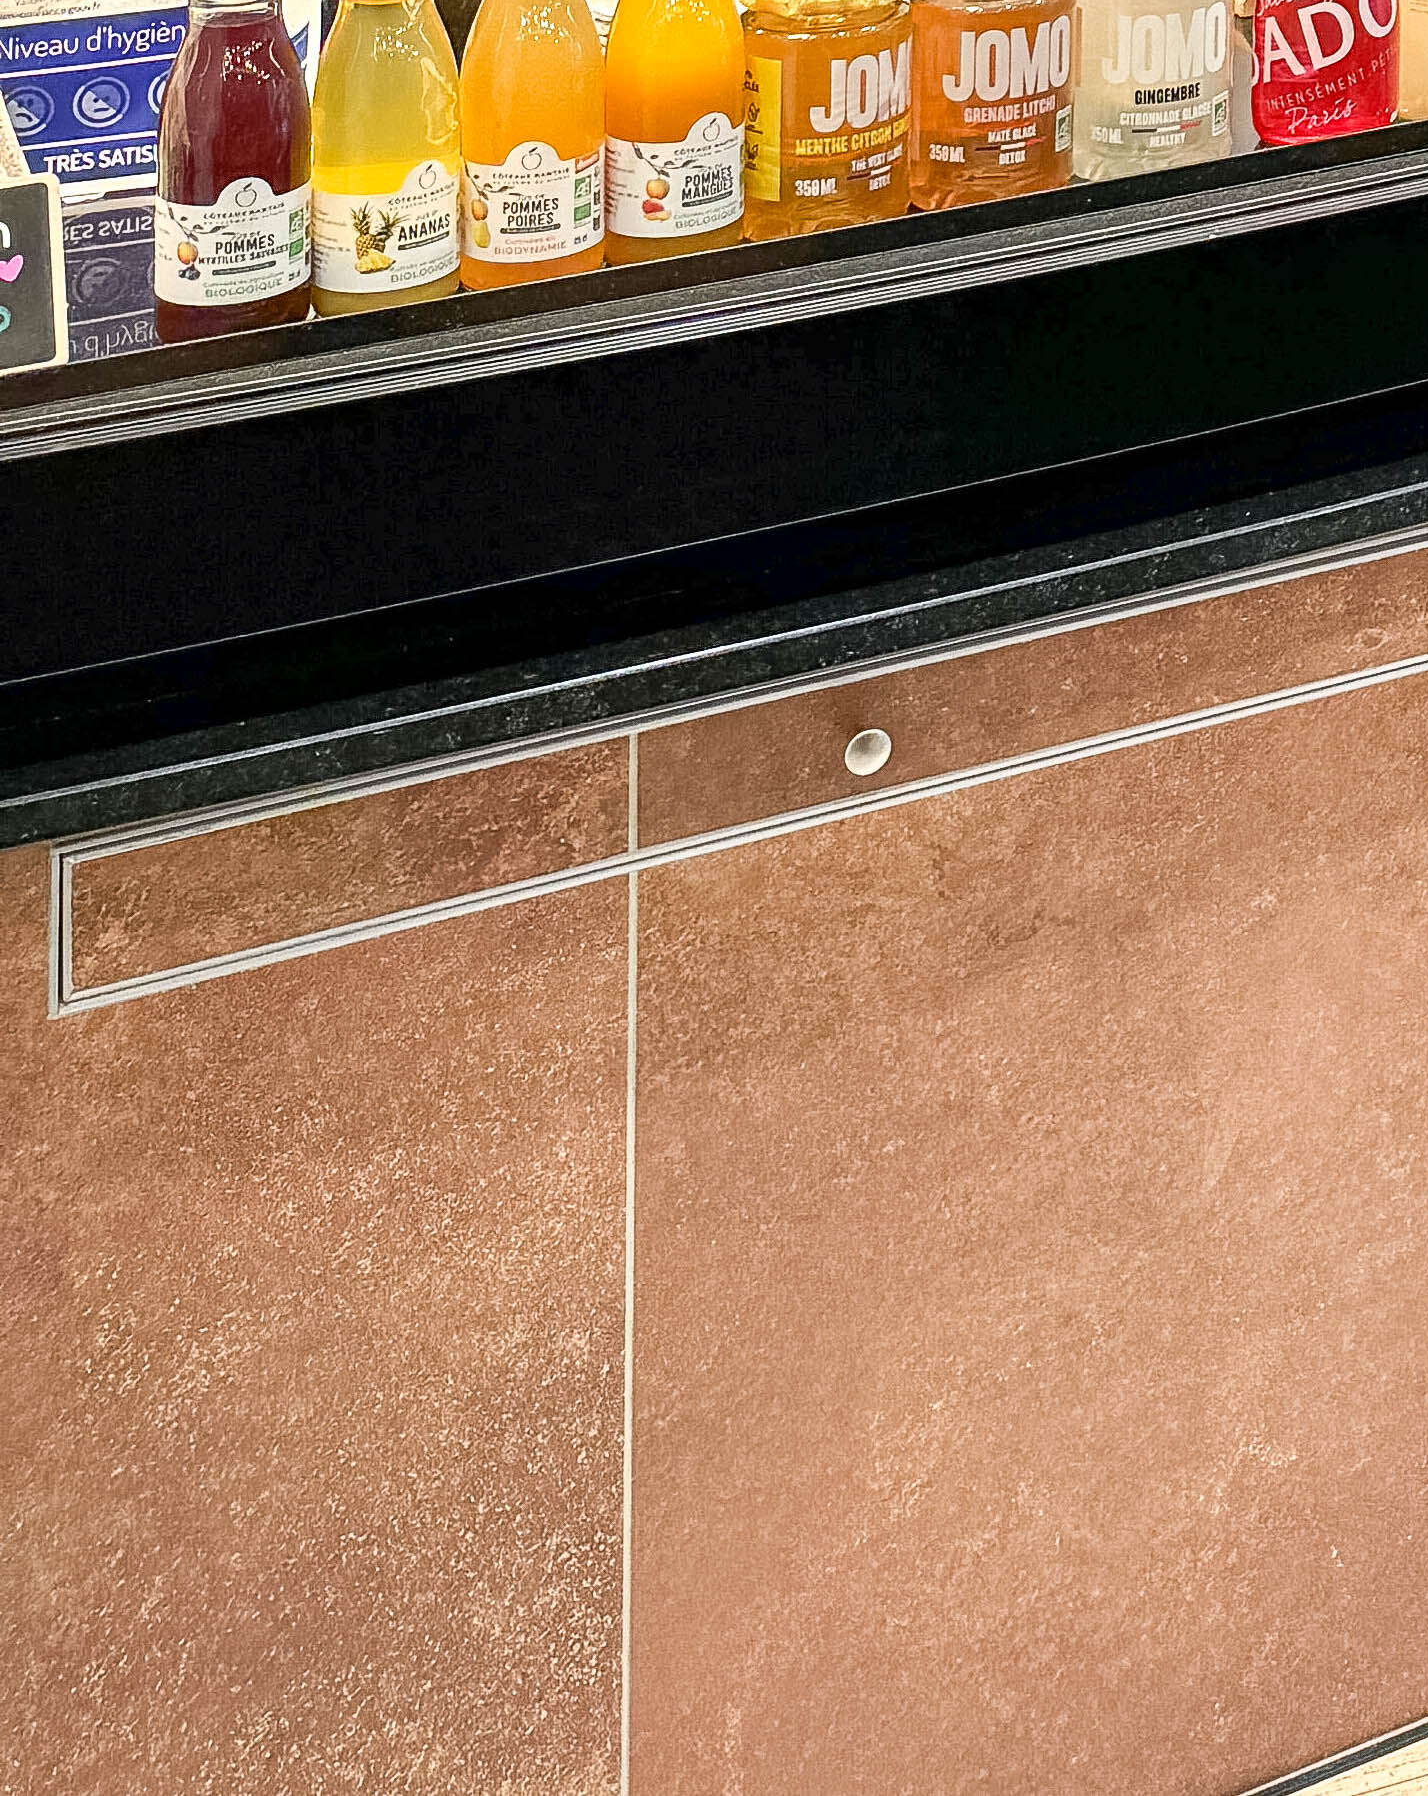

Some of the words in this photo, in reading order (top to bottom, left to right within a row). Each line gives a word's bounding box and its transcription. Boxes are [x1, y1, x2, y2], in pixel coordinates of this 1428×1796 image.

[1102, 1, 1226, 84] JOMO
[942, 15, 1070, 102] JOMO
[1135, 82, 1200, 105] GINGEMBRE
[964, 105, 1020, 123] GRENADE
[1023, 94, 1055, 118] LITCHI
[796, 136, 848, 156] MENTHE
[852, 125, 891, 150] CITRON
[1150, 132, 1186, 147] HEALTHY
[44, 147, 95, 173] TRÈS
[999, 150, 1026, 165] DETOX
[684, 166, 733, 187] POMMES
[682, 177, 733, 200] MANGUES
[502, 198, 559, 216] POMMES
[398, 216, 451, 242] ANANAS
[508, 212, 554, 228] POIRES
[215, 234, 275, 255] POMMES
[494, 241, 567, 255] BIODYNAMIE
